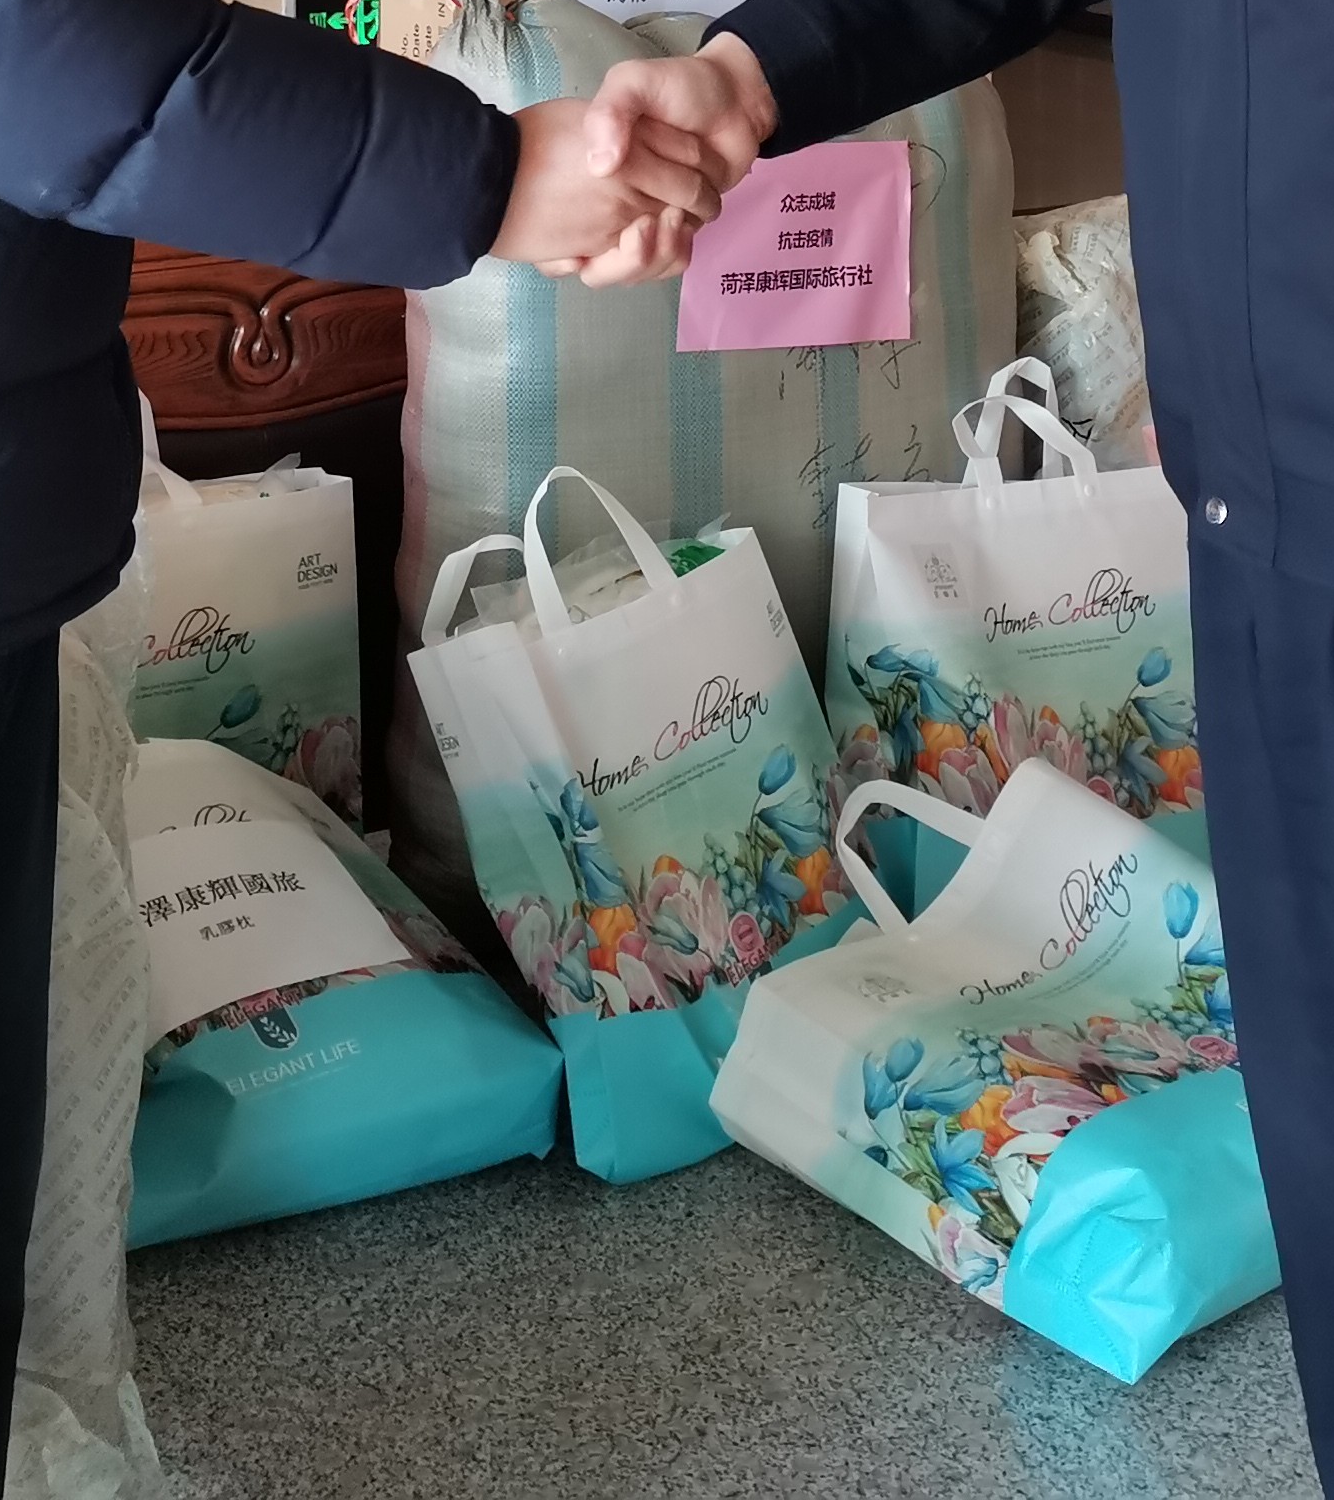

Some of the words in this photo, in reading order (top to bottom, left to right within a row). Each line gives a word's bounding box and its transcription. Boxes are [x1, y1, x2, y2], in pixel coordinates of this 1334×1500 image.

[437, 2, 445, 18] IN
[412, 22, 421, 58] Date
[780, 191, 836, 213] 众志成城
[778, 228, 834, 251] 抗击疫情
[720, 263, 873, 295] 菏泽康辉国际旅行社
[297, 563, 338, 583] DESIGN
[298, 553, 322, 569] ART
[984, 602, 1044, 643] Home
[1048, 568, 1156, 634] Collection
[577, 757, 649, 797] Home
[654, 675, 768, 761] Collection
[959, 971, 1043, 1005] Home
[1040, 853, 1138, 971] Collection
[224, 1052, 314, 1096] ELEGANT
[319, 1039, 361, 1065] LIFE
